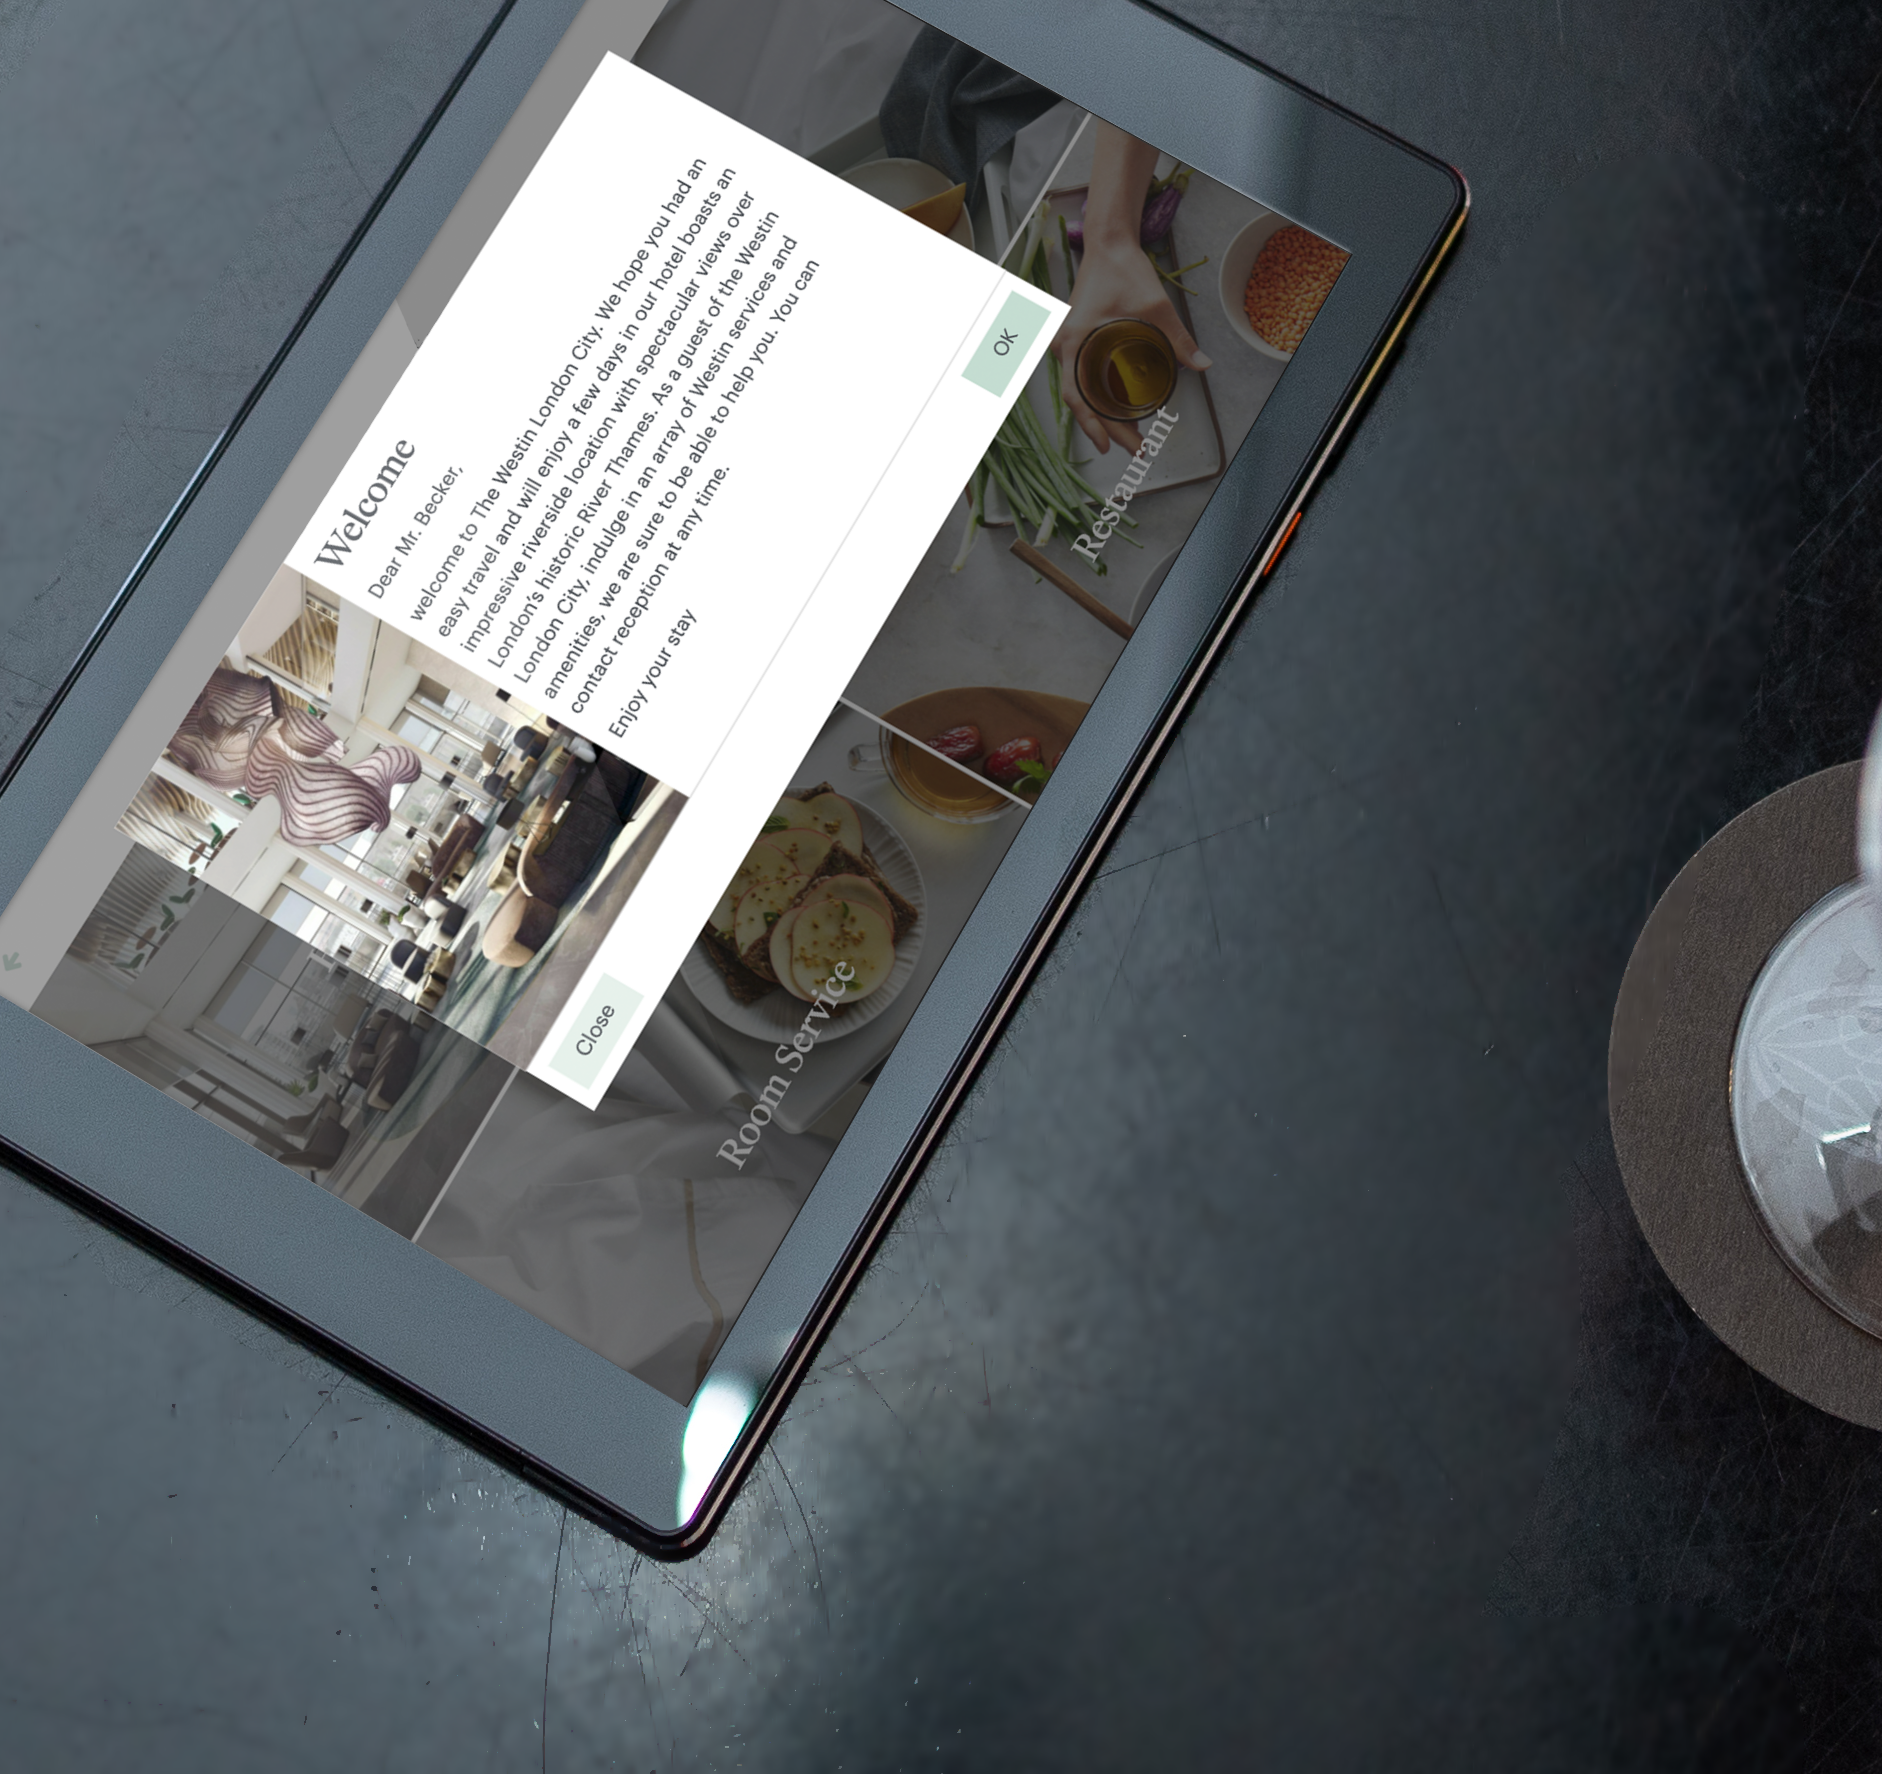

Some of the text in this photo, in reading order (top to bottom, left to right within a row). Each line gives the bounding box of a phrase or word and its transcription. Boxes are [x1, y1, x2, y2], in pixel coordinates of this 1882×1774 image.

[410, 158, 707, 621] welcome to The Westin London City. We hope you had an
[438, 168, 737, 637] easy travel and will enjoy a few days in our hotel boasts an
[460, 190, 755, 653] impressive riverside location with spectacular views over
[534, 525, 585, 590] historic
[576, 478, 612, 524] River
[604, 410, 659, 476] Thames.
[651, 382, 673, 407] As
[668, 369, 682, 382] a
[677, 318, 713, 369] guest
[707, 295, 725, 318] of
[717, 268, 743, 297] the
[734, 211, 780, 266] Westin
[994, 327, 1019, 356] OK
[313, 439, 415, 566] Welcome
[367, 466, 464, 599] Dear Mr. Becker,
[513, 234, 798, 684] London City, indulge in an array of Westin services and
[544, 260, 820, 699] amenities, we are sure to be able to help you. You can
[1070, 405, 1180, 564] Restaurant
[571, 467, 730, 714] contact reception at any time.
[608, 608, 697, 739] Enjoy your stay
[576, 1003, 616, 1057] Close
[716, 960, 856, 1171] Room Service
